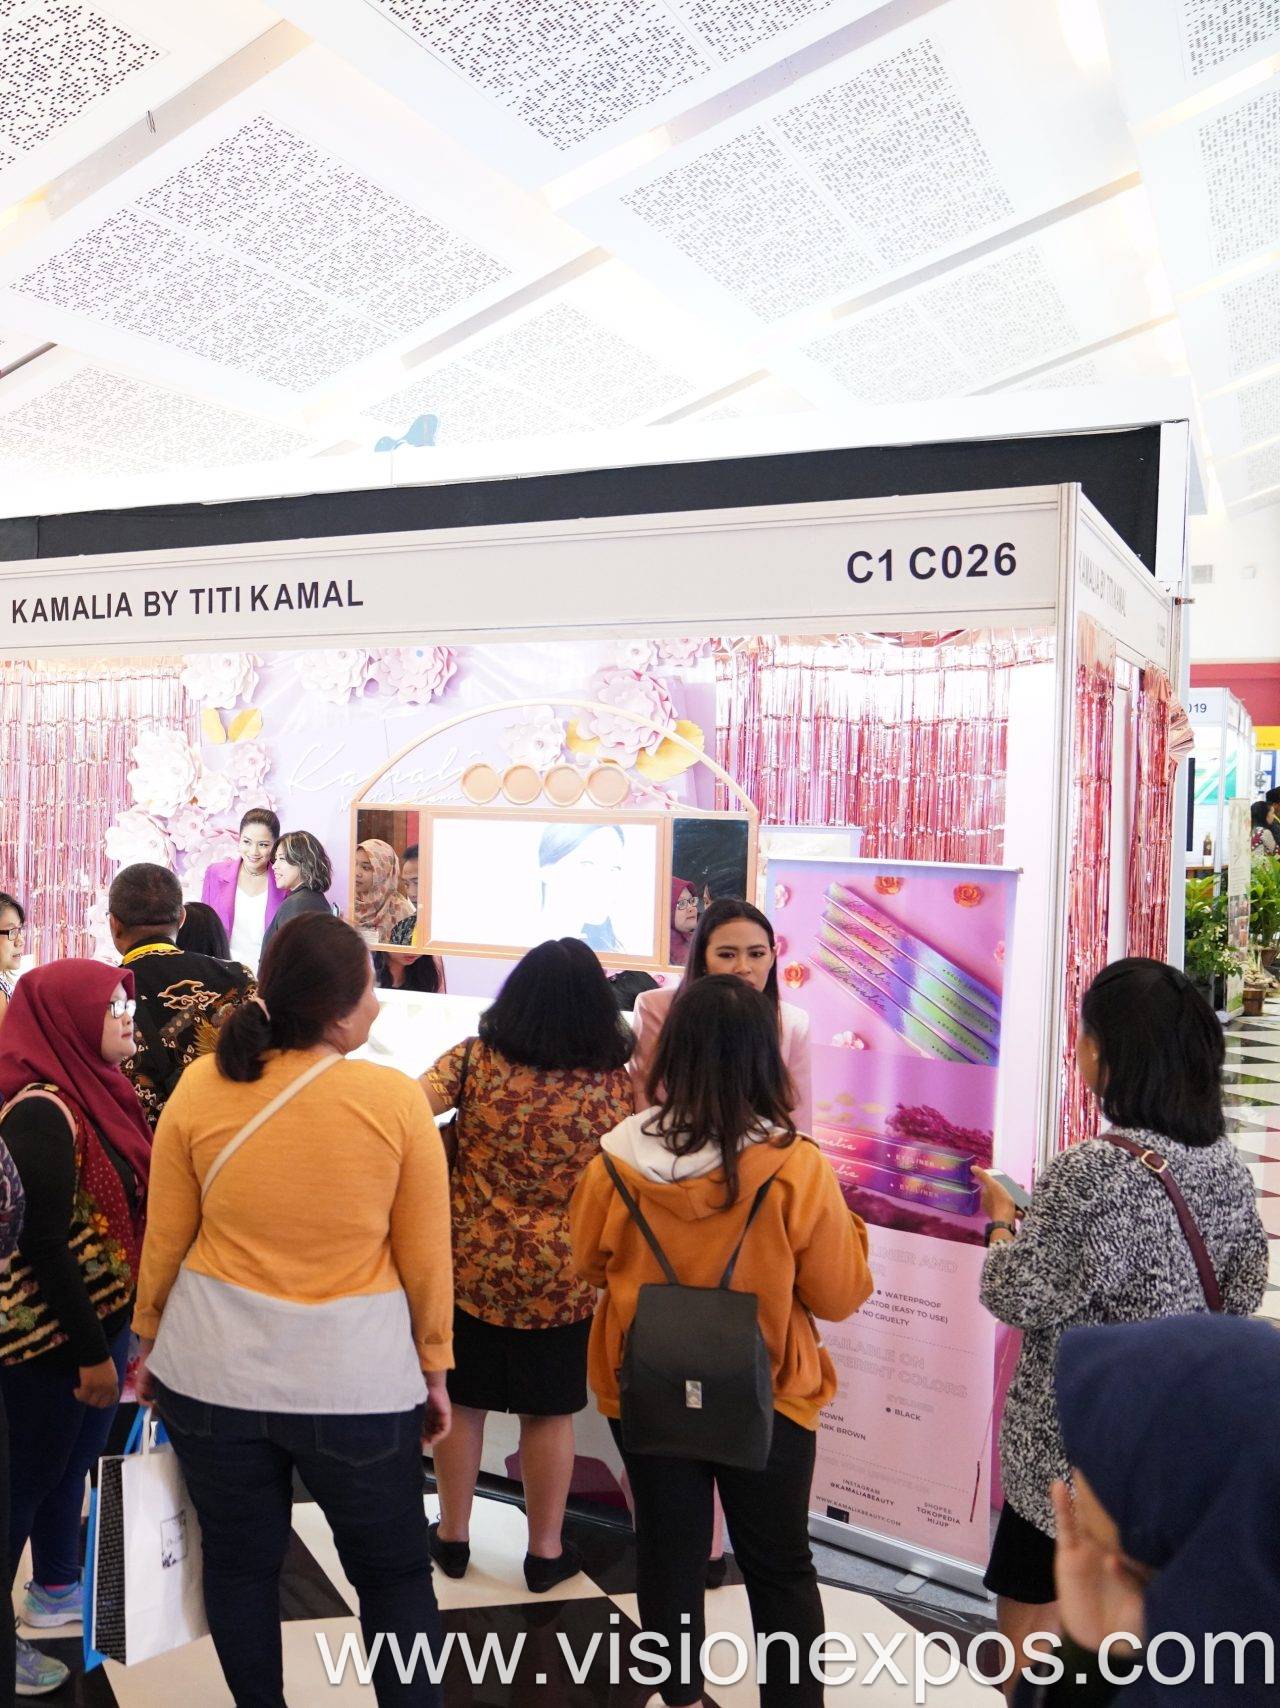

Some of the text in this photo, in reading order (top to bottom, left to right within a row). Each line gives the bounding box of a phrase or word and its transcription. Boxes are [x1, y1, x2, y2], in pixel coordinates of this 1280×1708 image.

[846, 541, 1017, 584] C1 C026
[12, 579, 364, 624] KAMALIA BY TITI KAMAL
[884, 1290, 942, 1309] WATERPROOF
[862, 1309, 910, 1327] NO CRUELTY
[891, 1304, 915, 1315] (EASY
[917, 1310, 928, 1319] TO
[819, 1410, 844, 1422] ROWN
[894, 1408, 922, 1422] BLACK
[820, 1422, 866, 1441] ARK BROWN
[830, 1482, 896, 1507] @KAMALIABEAUTY
[842, 1479, 881, 1496] INSTAGRAM
[915, 1506, 961, 1525] TOKOPEDIA
